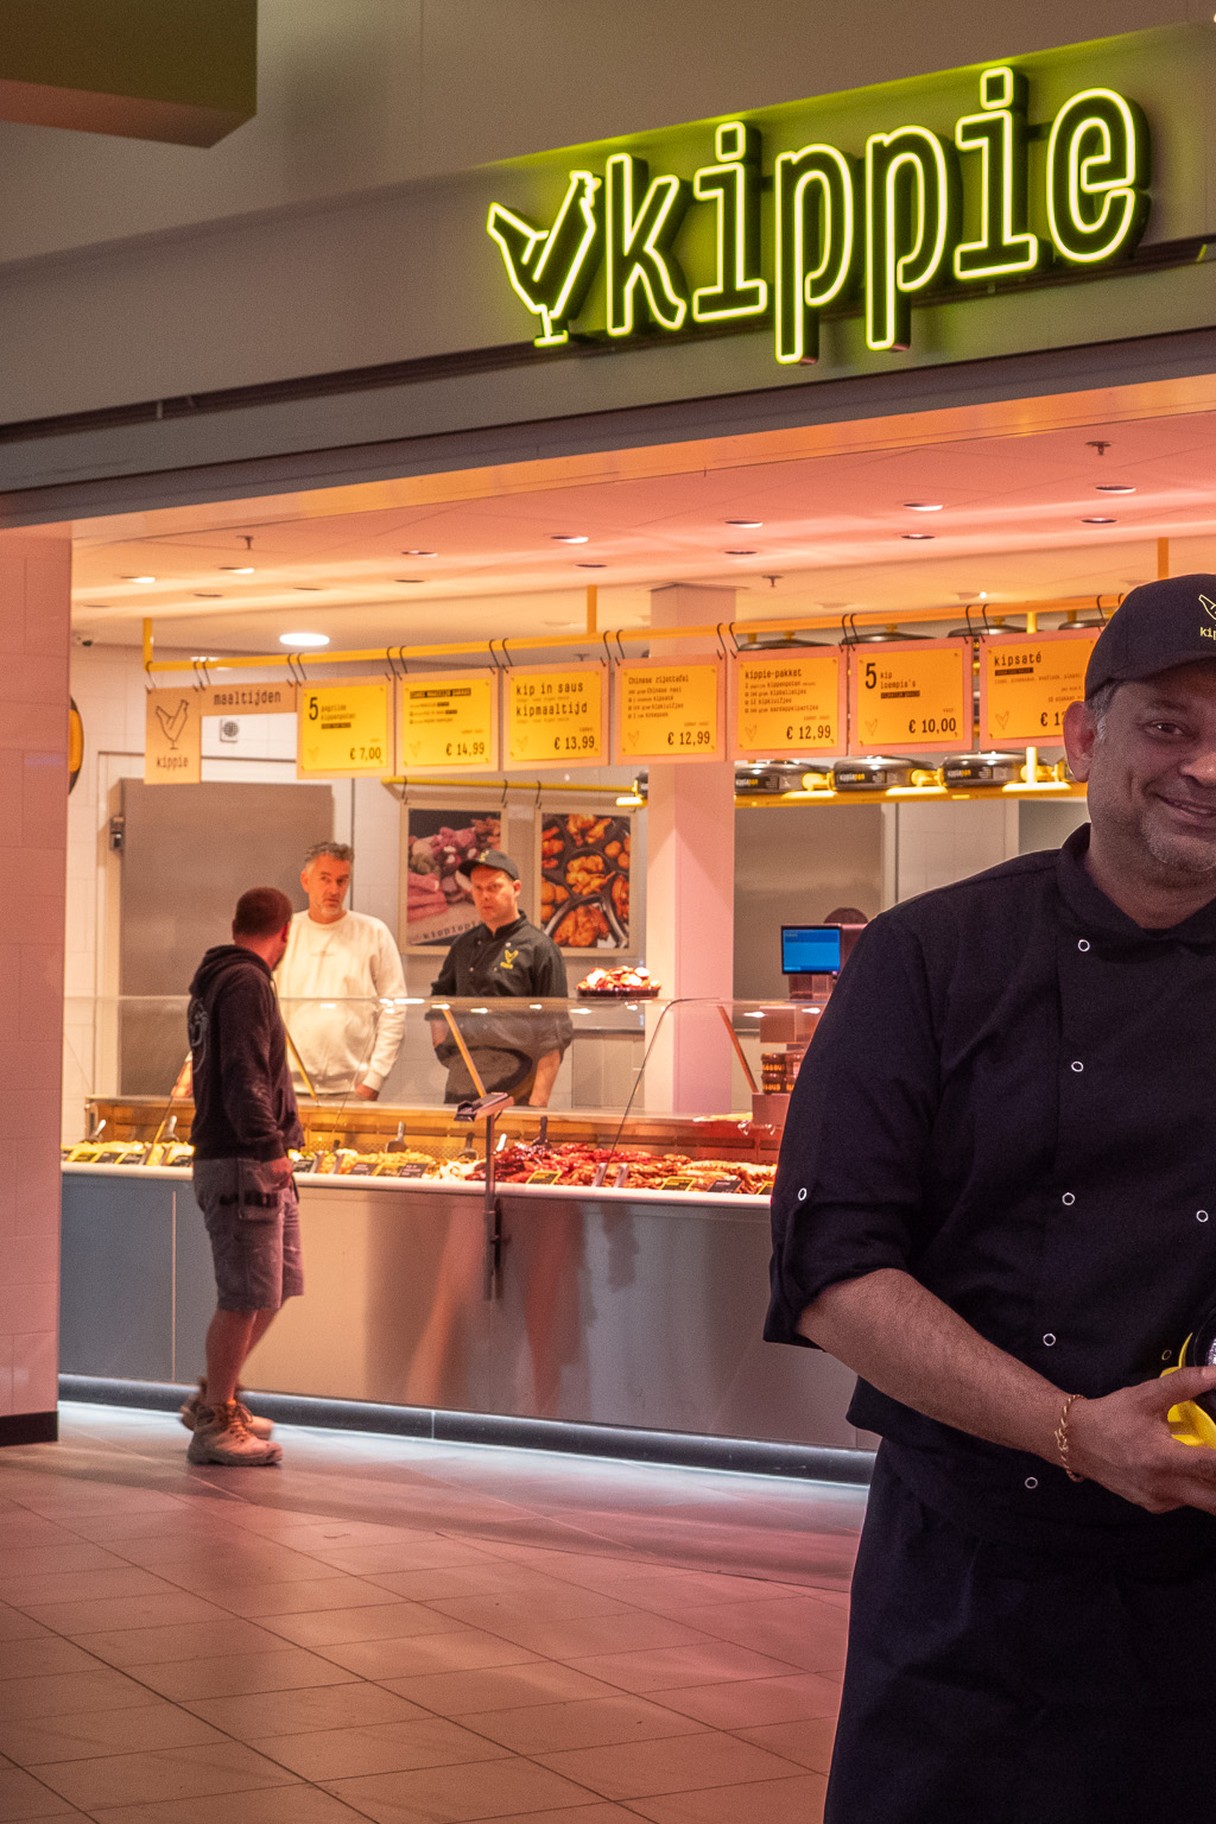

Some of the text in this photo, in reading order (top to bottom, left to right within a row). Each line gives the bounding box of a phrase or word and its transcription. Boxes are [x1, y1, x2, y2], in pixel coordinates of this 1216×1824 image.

[605, 65, 1140, 365] kippie
[994, 651, 1042, 667] kipsaté
[865, 662, 877, 689] 5
[516, 682, 583, 696] kip in saus
[213, 689, 281, 707] maaltijden
[309, 696, 319, 720] 5
[516, 701, 588, 717] kipmaaltijd
[909, 717, 956, 734] € 10,00
[1040, 712, 1048, 727] €
[668, 731, 710, 746] € 12,99
[786, 725, 831, 740] € 12,99
[446, 741, 485, 756] € 14,99
[554, 735, 595, 751] € 13,99
[350, 746, 382, 760] € 7,00
[156, 753, 189, 770] kippie
